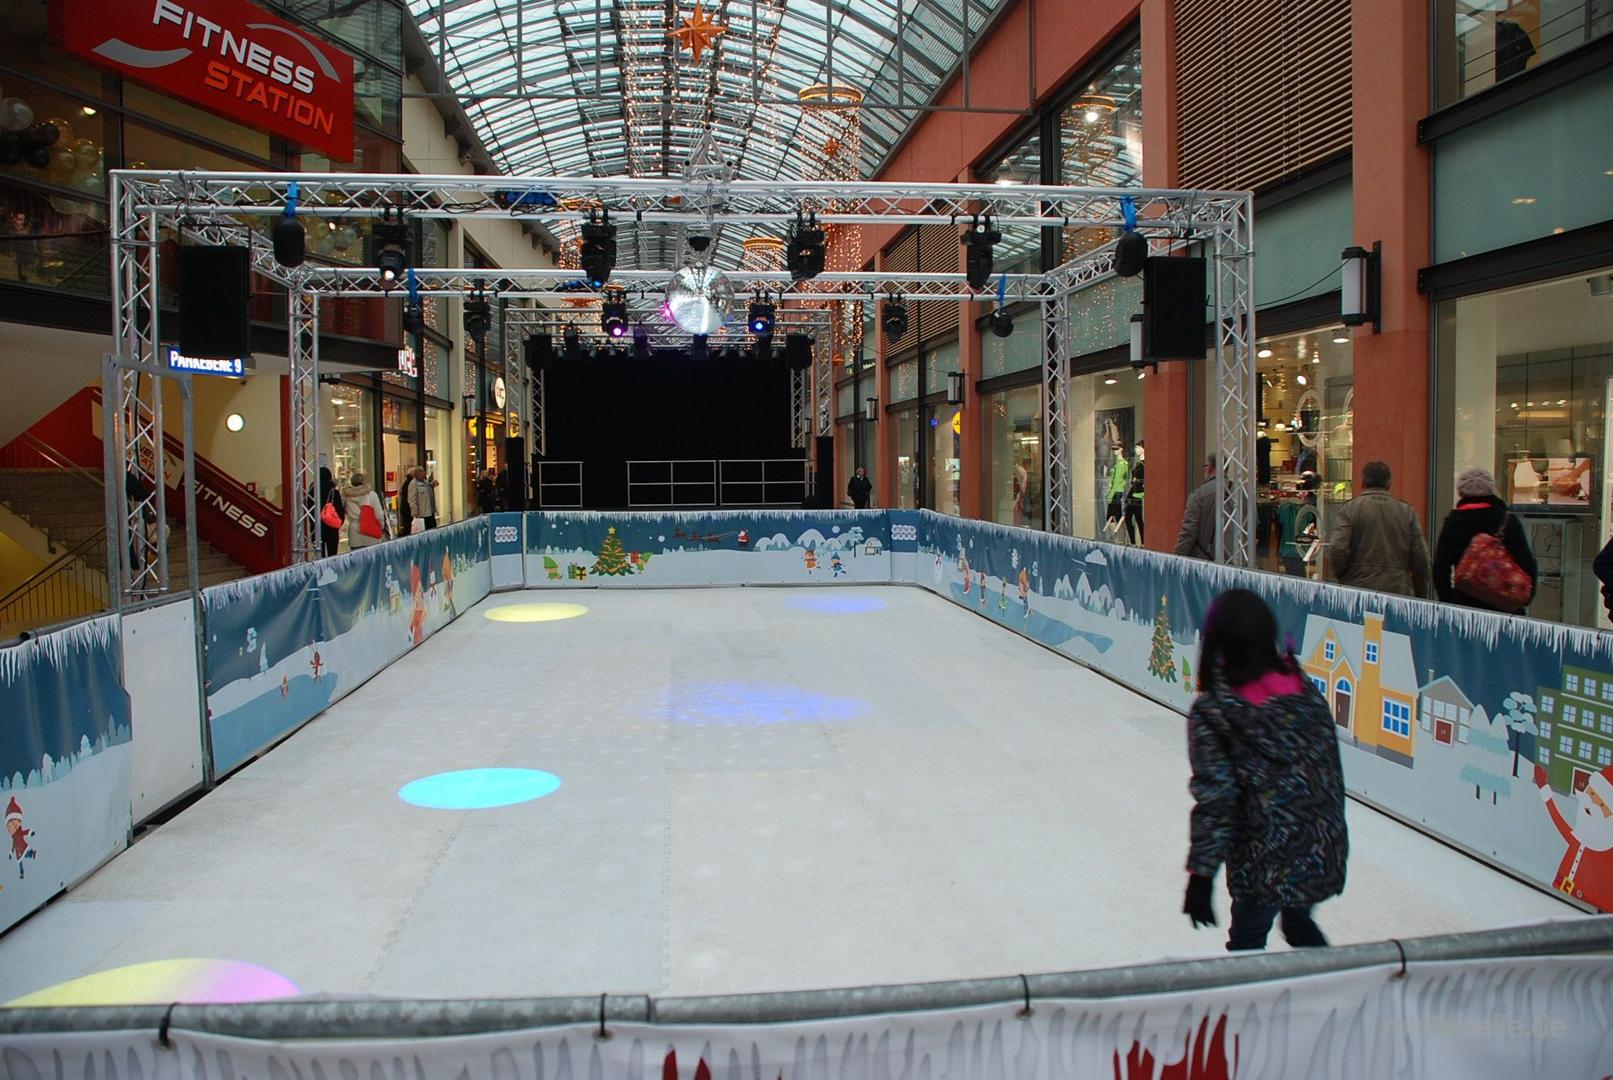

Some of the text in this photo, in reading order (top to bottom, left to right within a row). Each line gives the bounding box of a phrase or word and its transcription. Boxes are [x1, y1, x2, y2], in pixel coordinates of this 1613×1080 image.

[153, 0, 315, 94] FITNESS
[205, 61, 334, 135] STATION
[234, 358, 242, 374] 9
